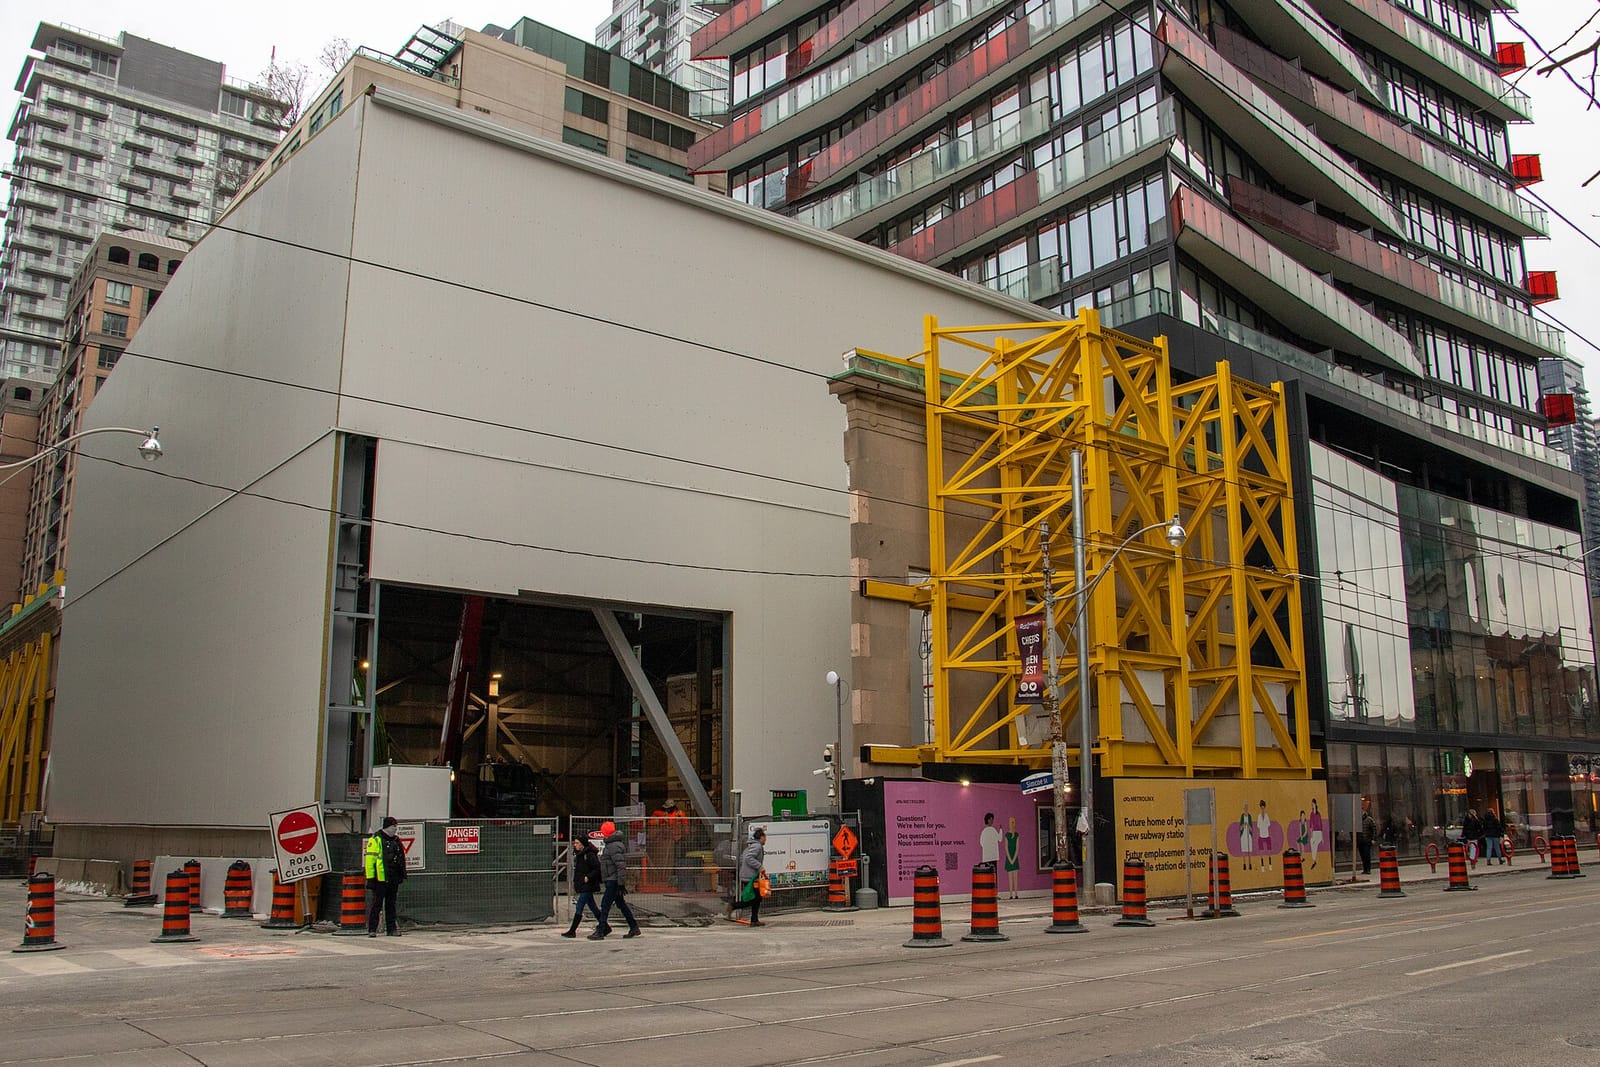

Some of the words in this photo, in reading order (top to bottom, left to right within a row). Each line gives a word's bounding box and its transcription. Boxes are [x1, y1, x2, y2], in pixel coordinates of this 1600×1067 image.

[1124, 817, 1146, 827] Future
[1146, 816, 1166, 826] home
[1166, 815, 1174, 825] of
[1174, 818, 1184, 828] you
[447, 828, 479, 838] DANGER
[1124, 833, 1140, 841] new
[1140, 830, 1166, 842] subway
[1166, 828, 1184, 839] statio
[289, 854, 316, 866] ROAD
[1125, 850, 1143, 859] Futur
[1144, 848, 1185, 860] emplacemen
[1196, 847, 1213, 855] votre
[285, 863, 324, 877] CLOSED
[1154, 861, 1177, 871] station
[1177, 860, 1186, 870] de
